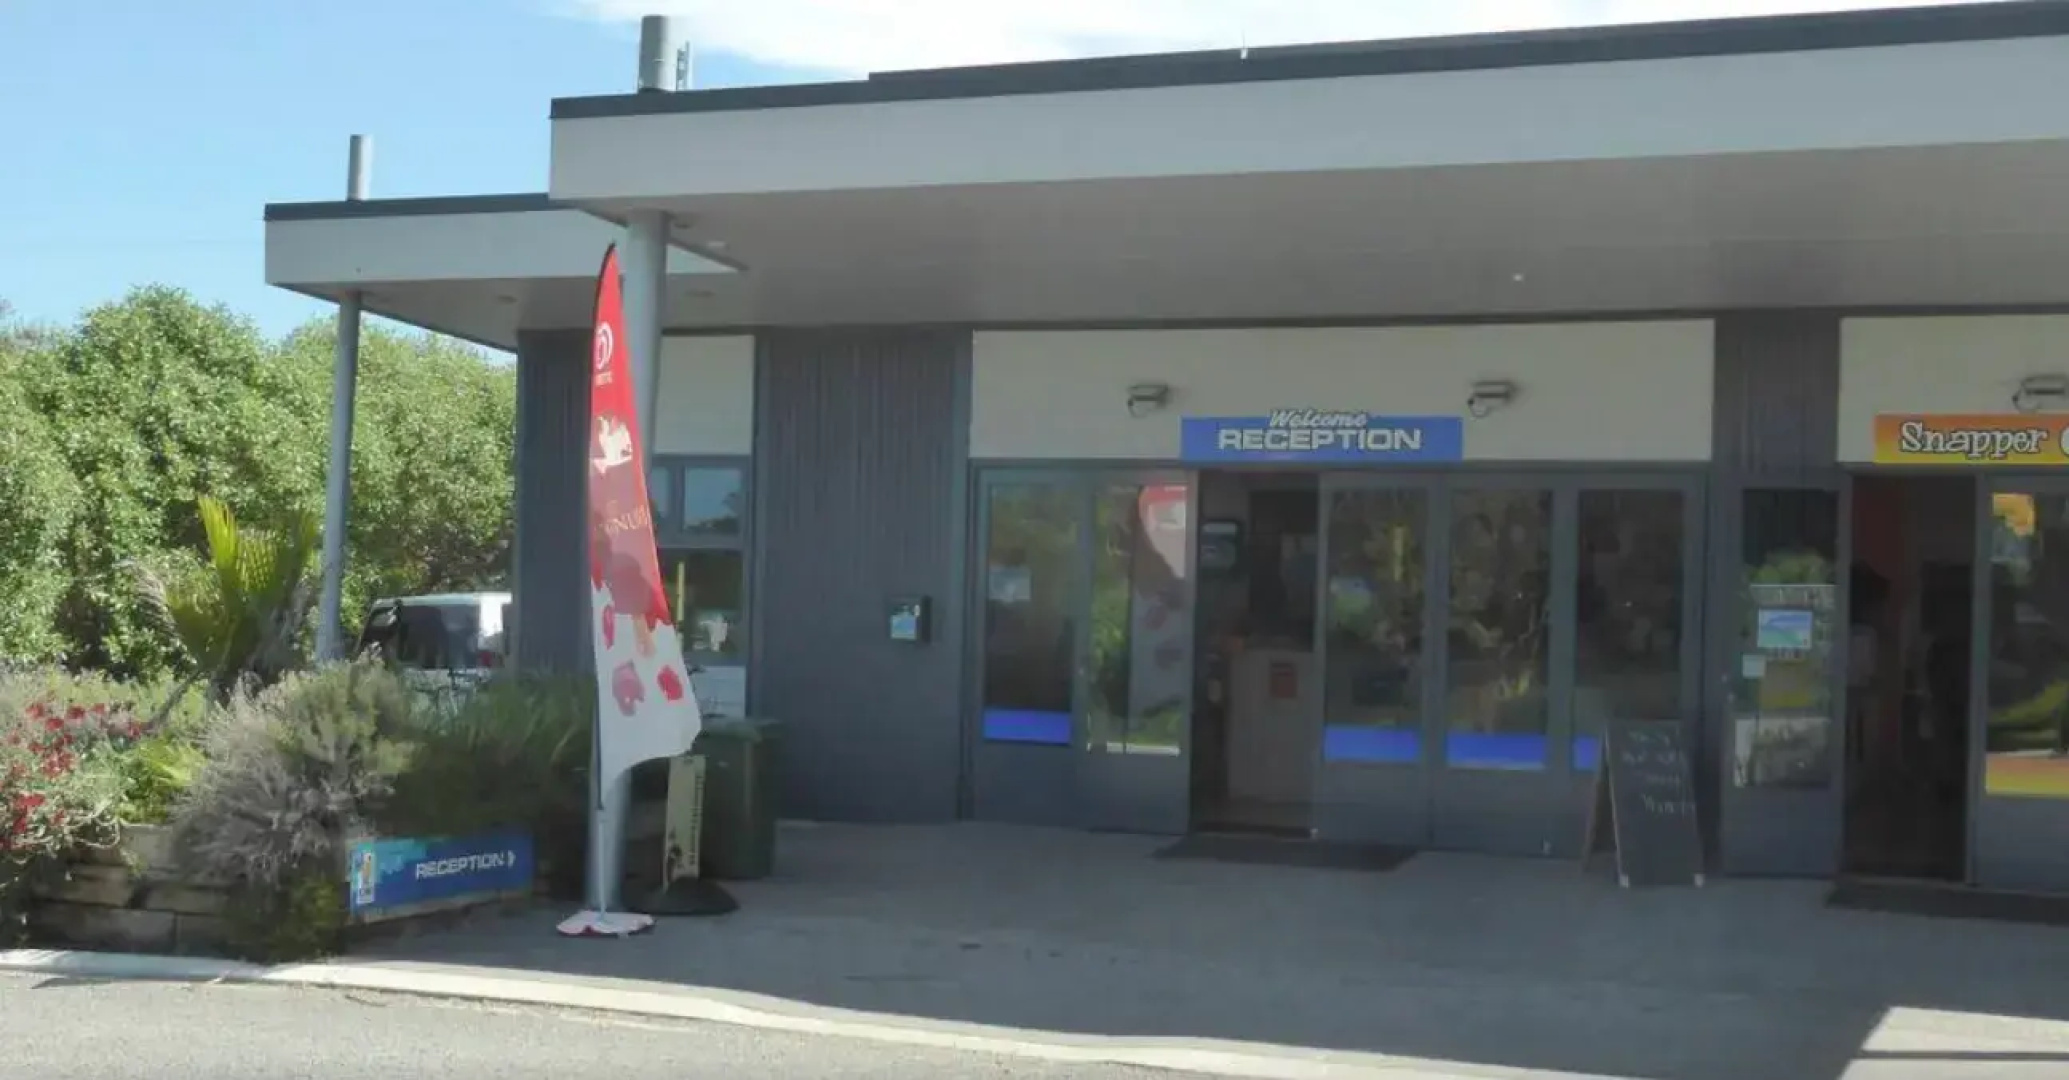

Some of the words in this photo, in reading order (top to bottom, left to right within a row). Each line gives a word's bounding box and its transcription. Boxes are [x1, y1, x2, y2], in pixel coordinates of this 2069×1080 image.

[1269, 408, 1368, 428] Welcome
[1218, 428, 1422, 450] RECEPTION
[1901, 420, 2048, 457] Snapper
[416, 852, 504, 879] RECEPTION
